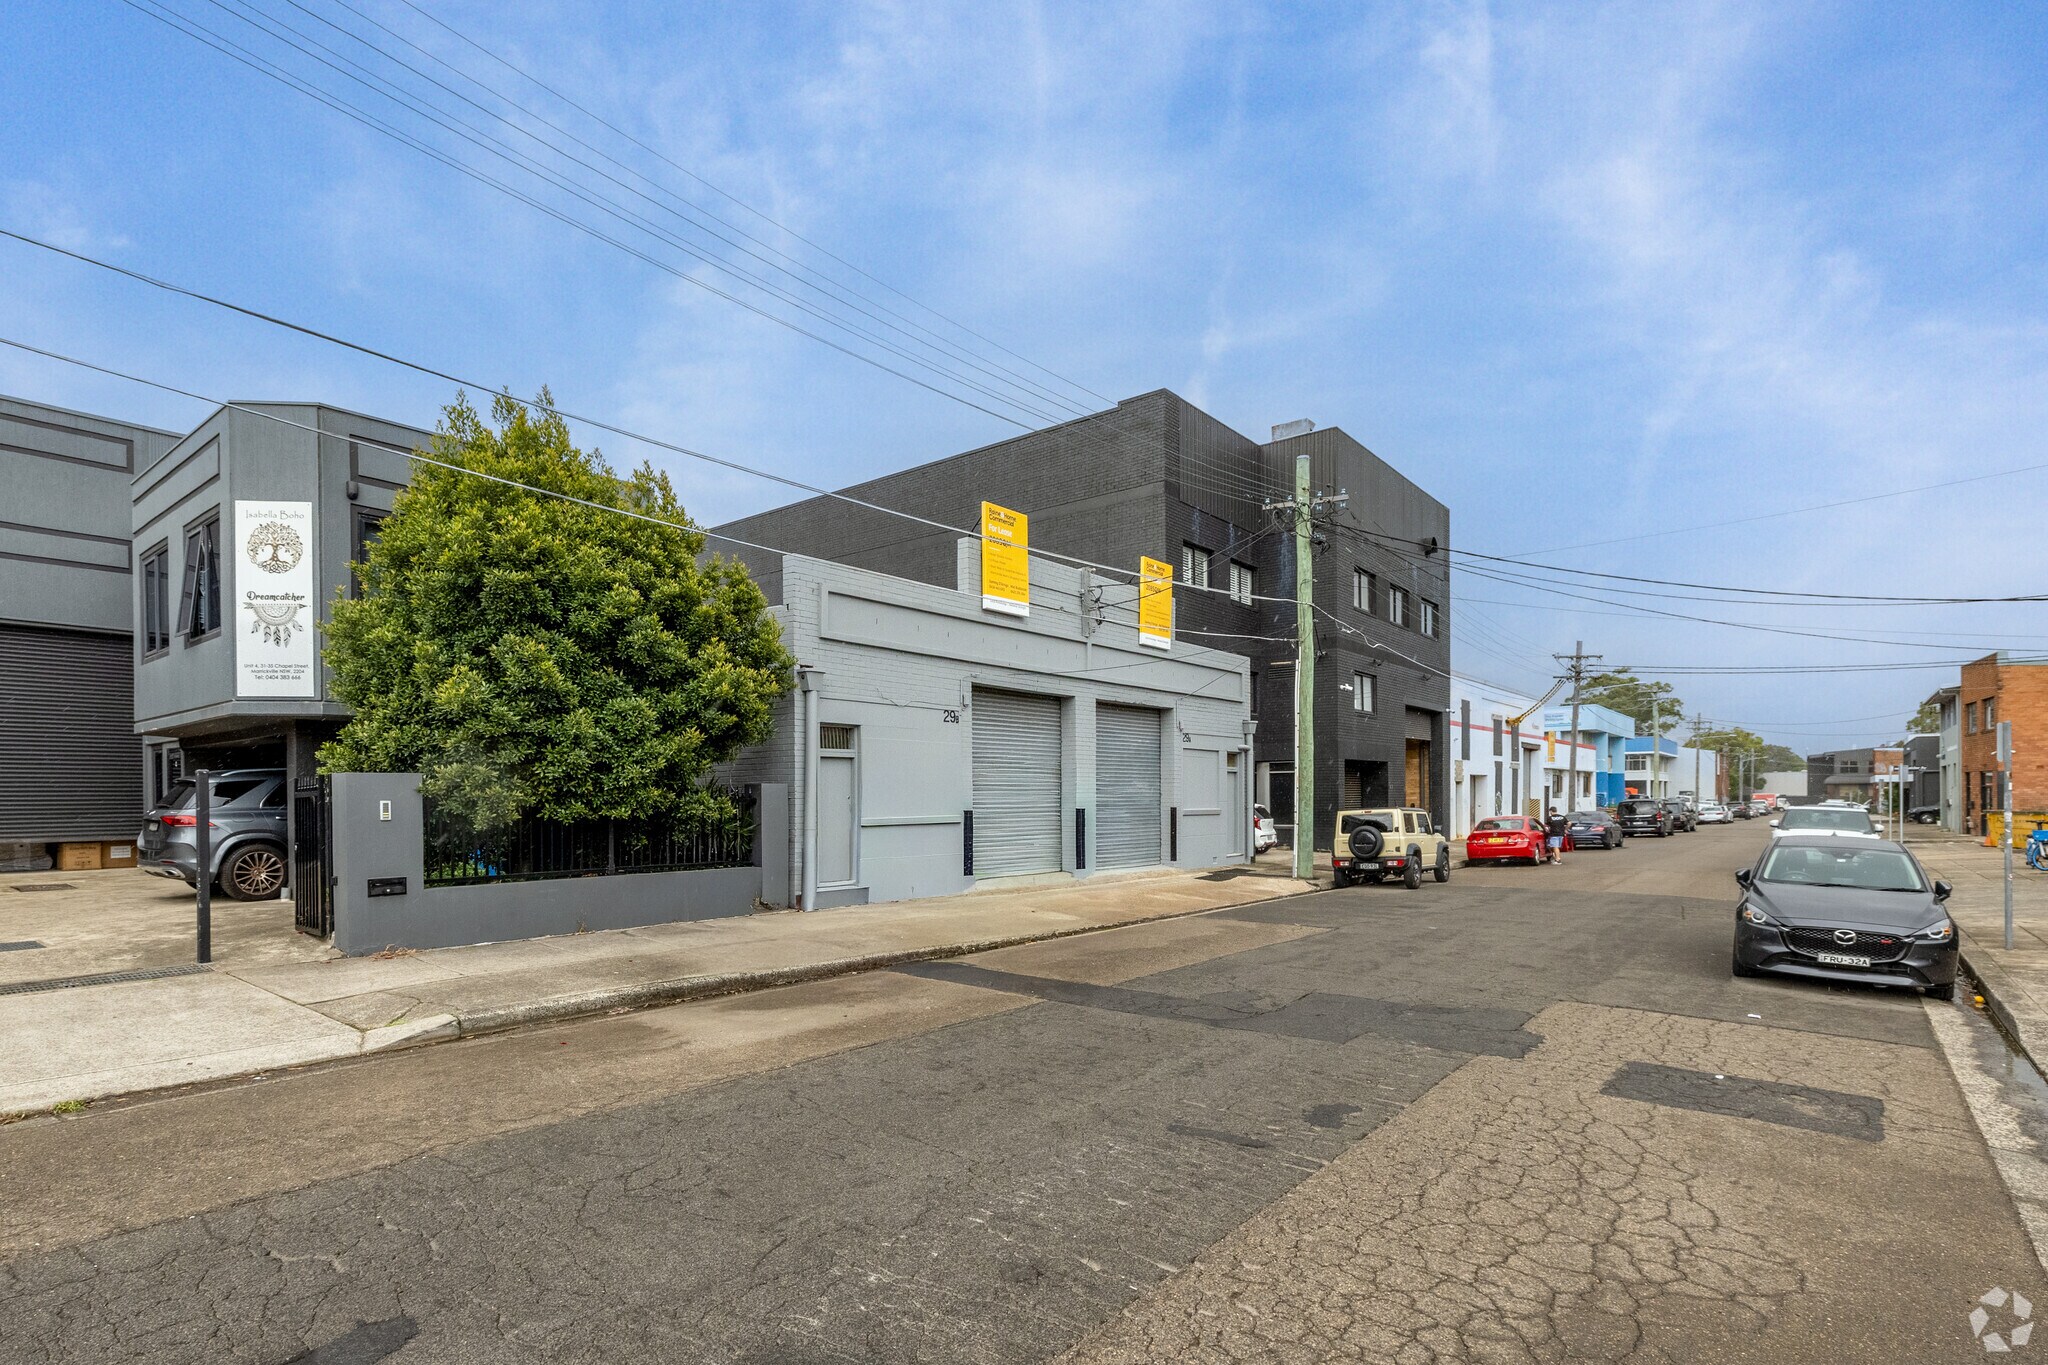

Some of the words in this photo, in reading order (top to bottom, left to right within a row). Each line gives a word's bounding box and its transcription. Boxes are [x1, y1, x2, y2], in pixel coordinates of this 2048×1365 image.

[246, 510, 278, 519] Isabella
[280, 510, 304, 520] Boho
[989, 513, 1014, 527] Commercial
[246, 591, 305, 602] Dreamcatcher
